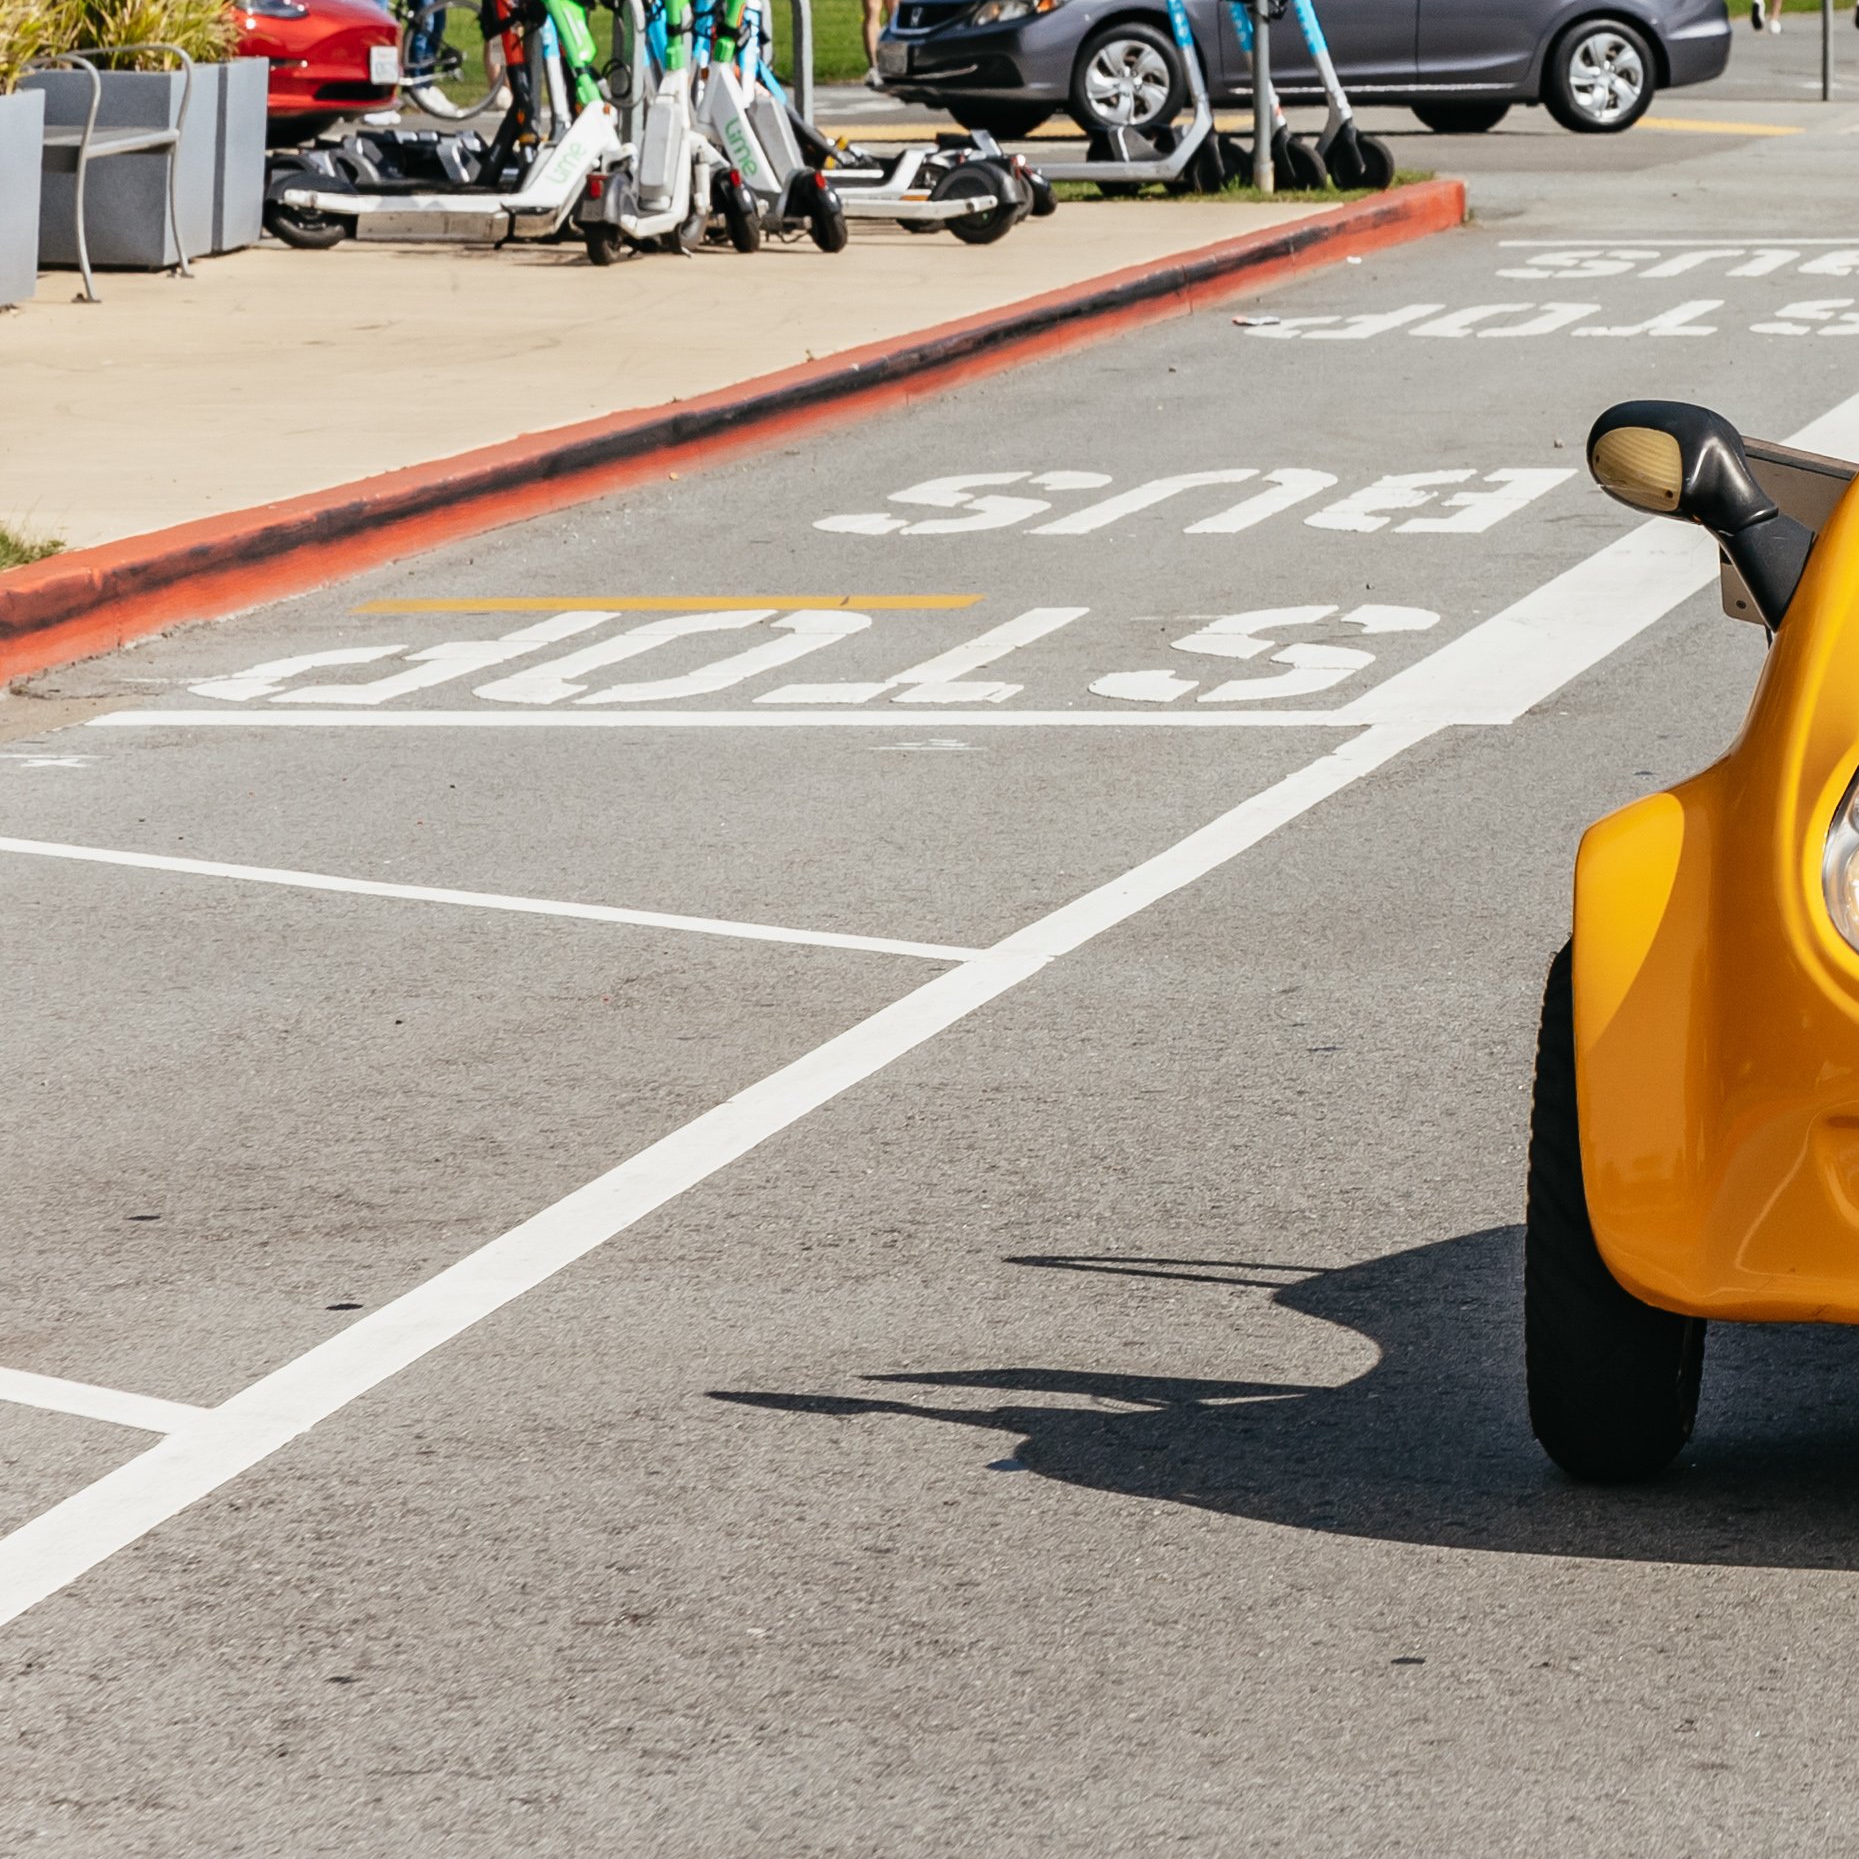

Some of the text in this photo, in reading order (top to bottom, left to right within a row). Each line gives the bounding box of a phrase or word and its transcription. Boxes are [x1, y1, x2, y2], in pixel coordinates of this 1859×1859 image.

[546, 141, 586, 185] Lime
[724, 116, 758, 177] Lime
[811, 467, 1582, 537] BUS
[187, 604, 1443, 704] STOP
